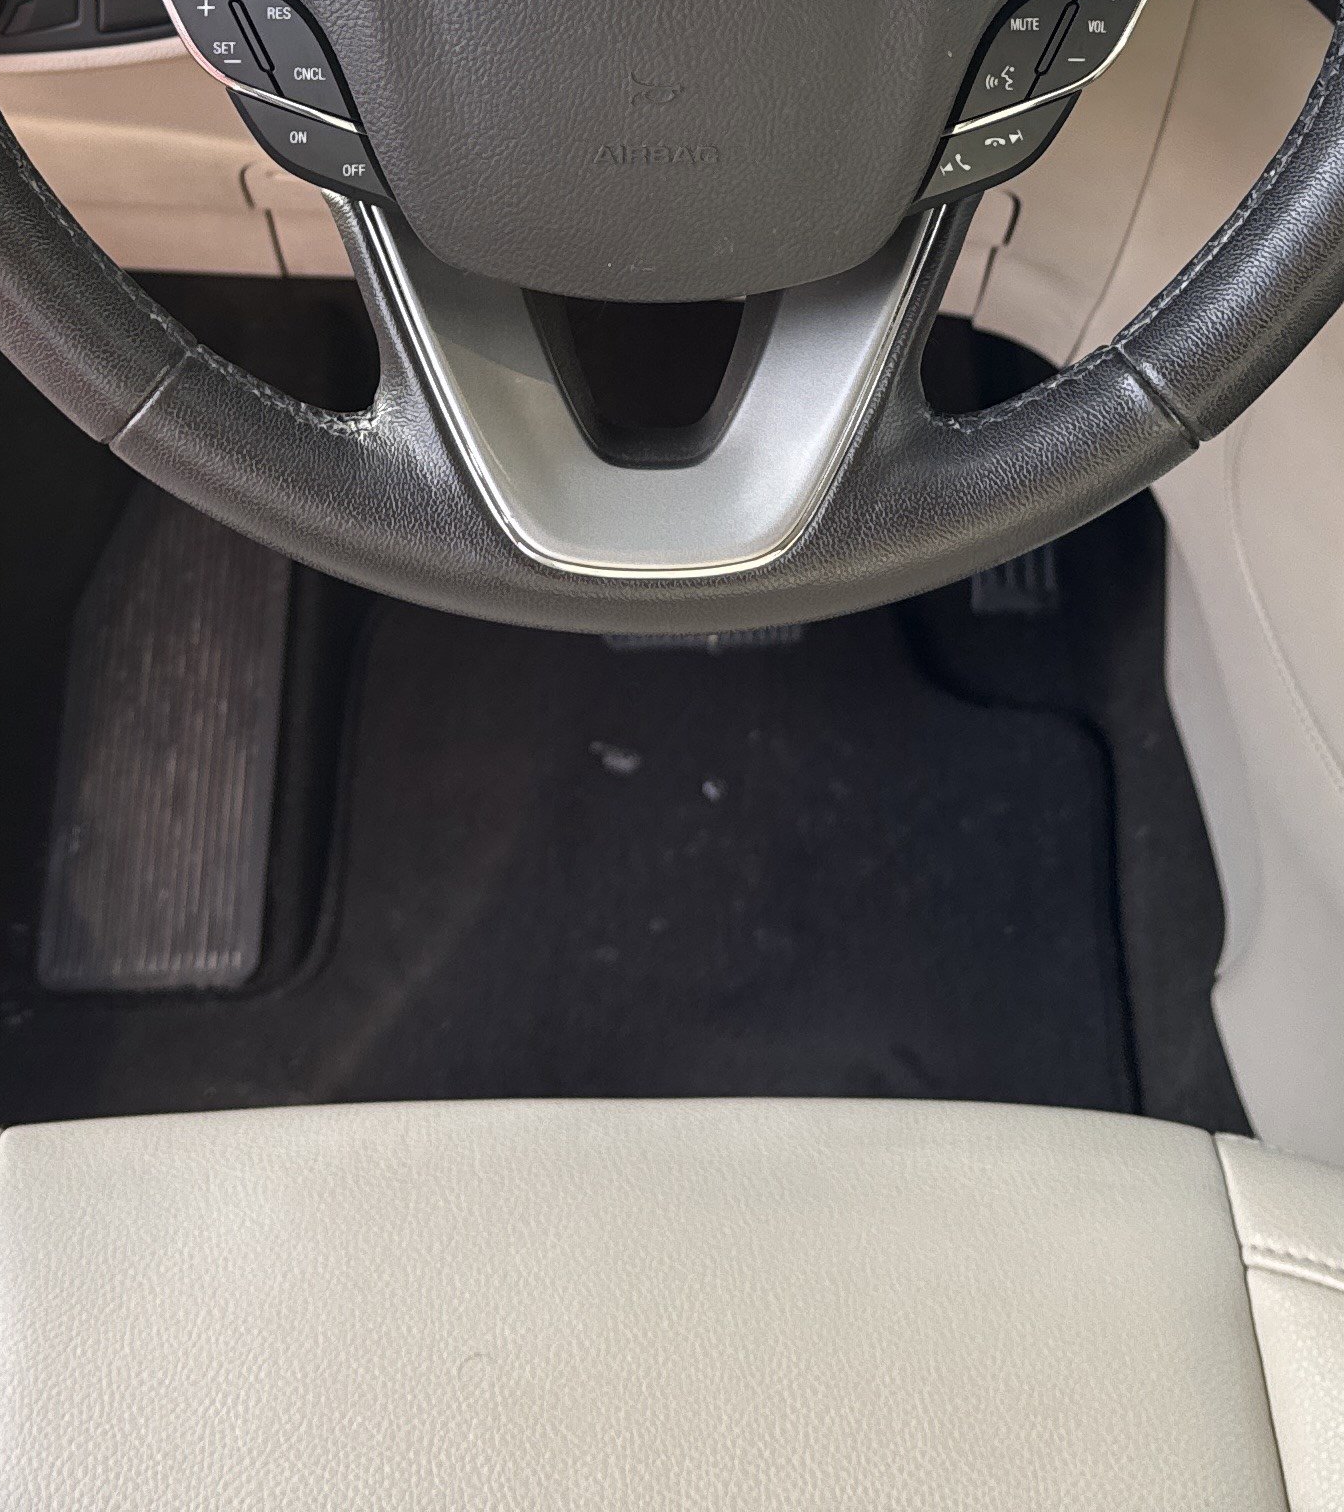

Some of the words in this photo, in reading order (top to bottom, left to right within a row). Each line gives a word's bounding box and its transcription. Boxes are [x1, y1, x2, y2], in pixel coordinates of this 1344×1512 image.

[267, 7, 291, 20] RES
[1010, 18, 1040, 31] MUTE
[1088, 20, 1107, 33] VOL
[213, 42, 236, 55] SET
[293, 67, 326, 81] CNCL
[290, 131, 307, 144] ON
[342, 163, 366, 176] OFF
